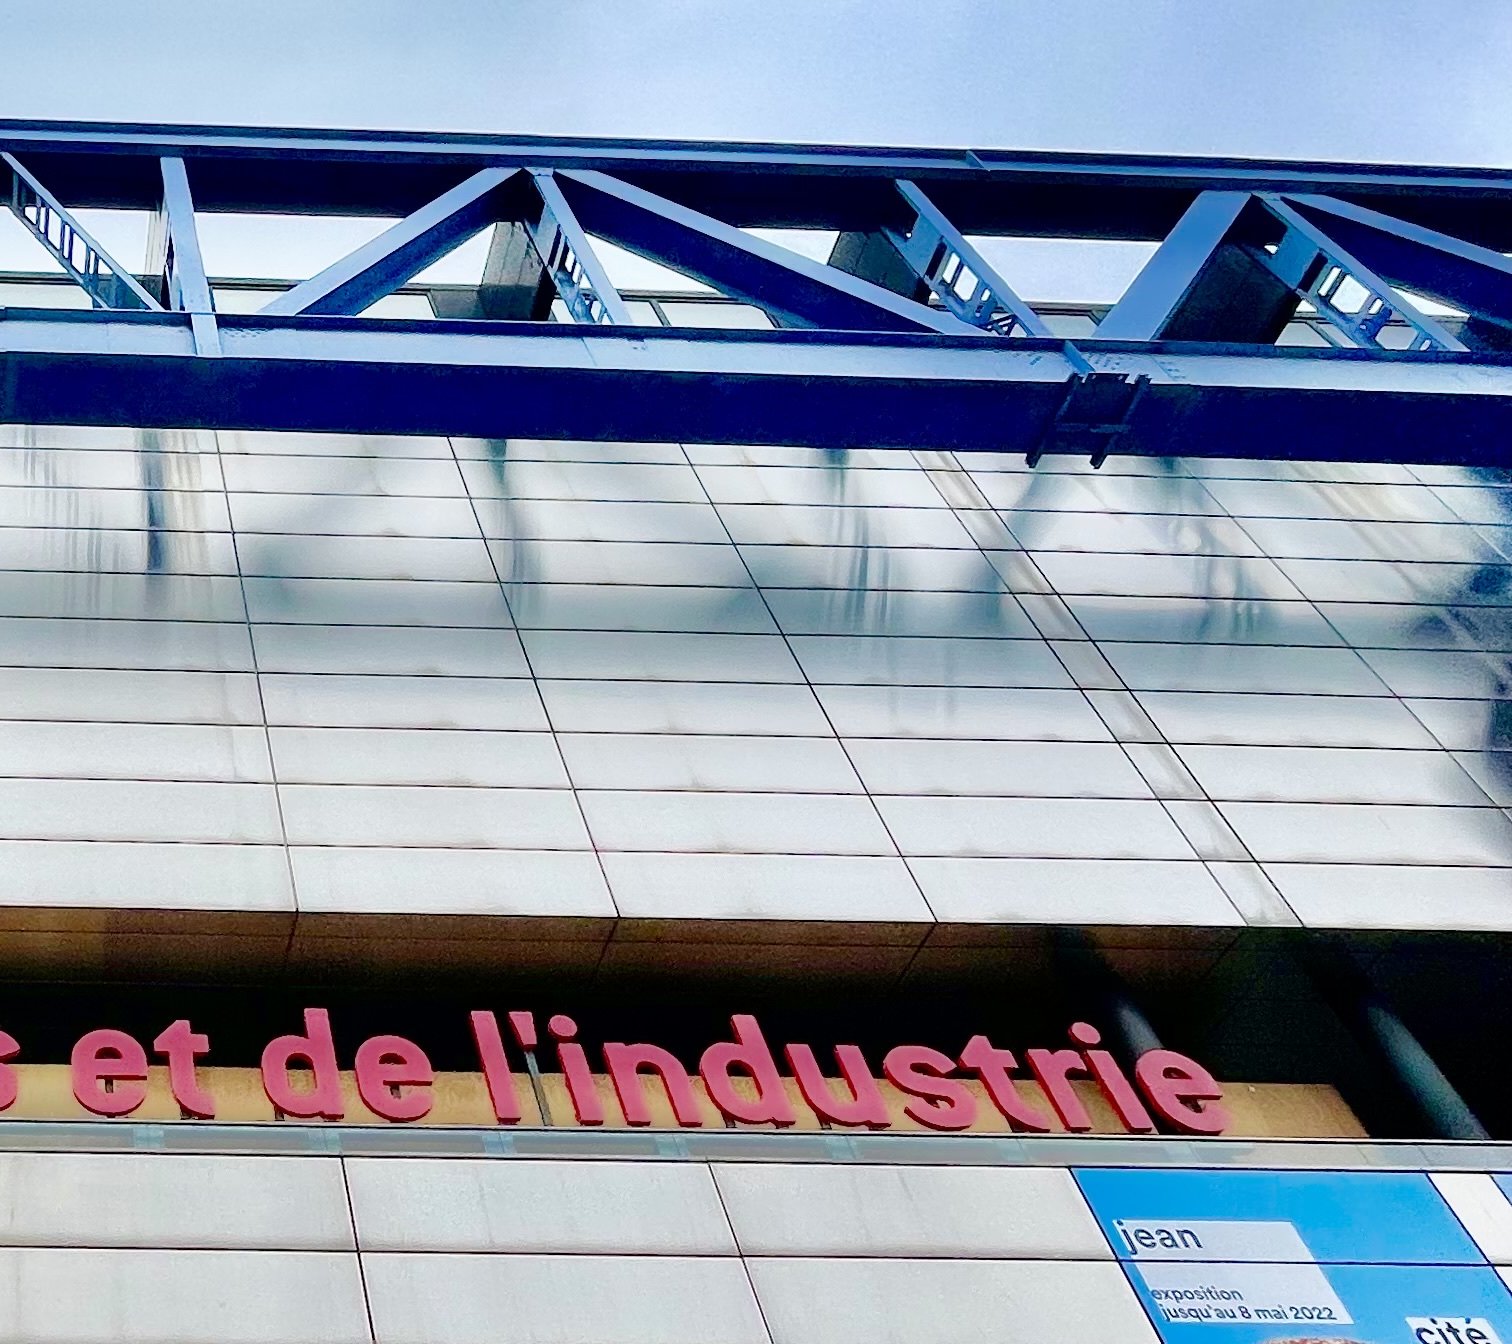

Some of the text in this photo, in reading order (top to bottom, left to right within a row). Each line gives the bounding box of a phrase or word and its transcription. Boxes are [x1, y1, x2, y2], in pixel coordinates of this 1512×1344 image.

[71, 1019, 215, 1120] et
[261, 1007, 434, 1123] de
[469, 1010, 1232, 1136] l'industrie
[1115, 1219, 1204, 1256] jean
[1151, 1285, 1244, 1304] exposition
[1158, 1303, 1338, 1323] jusqu'au 8 mai 2022
